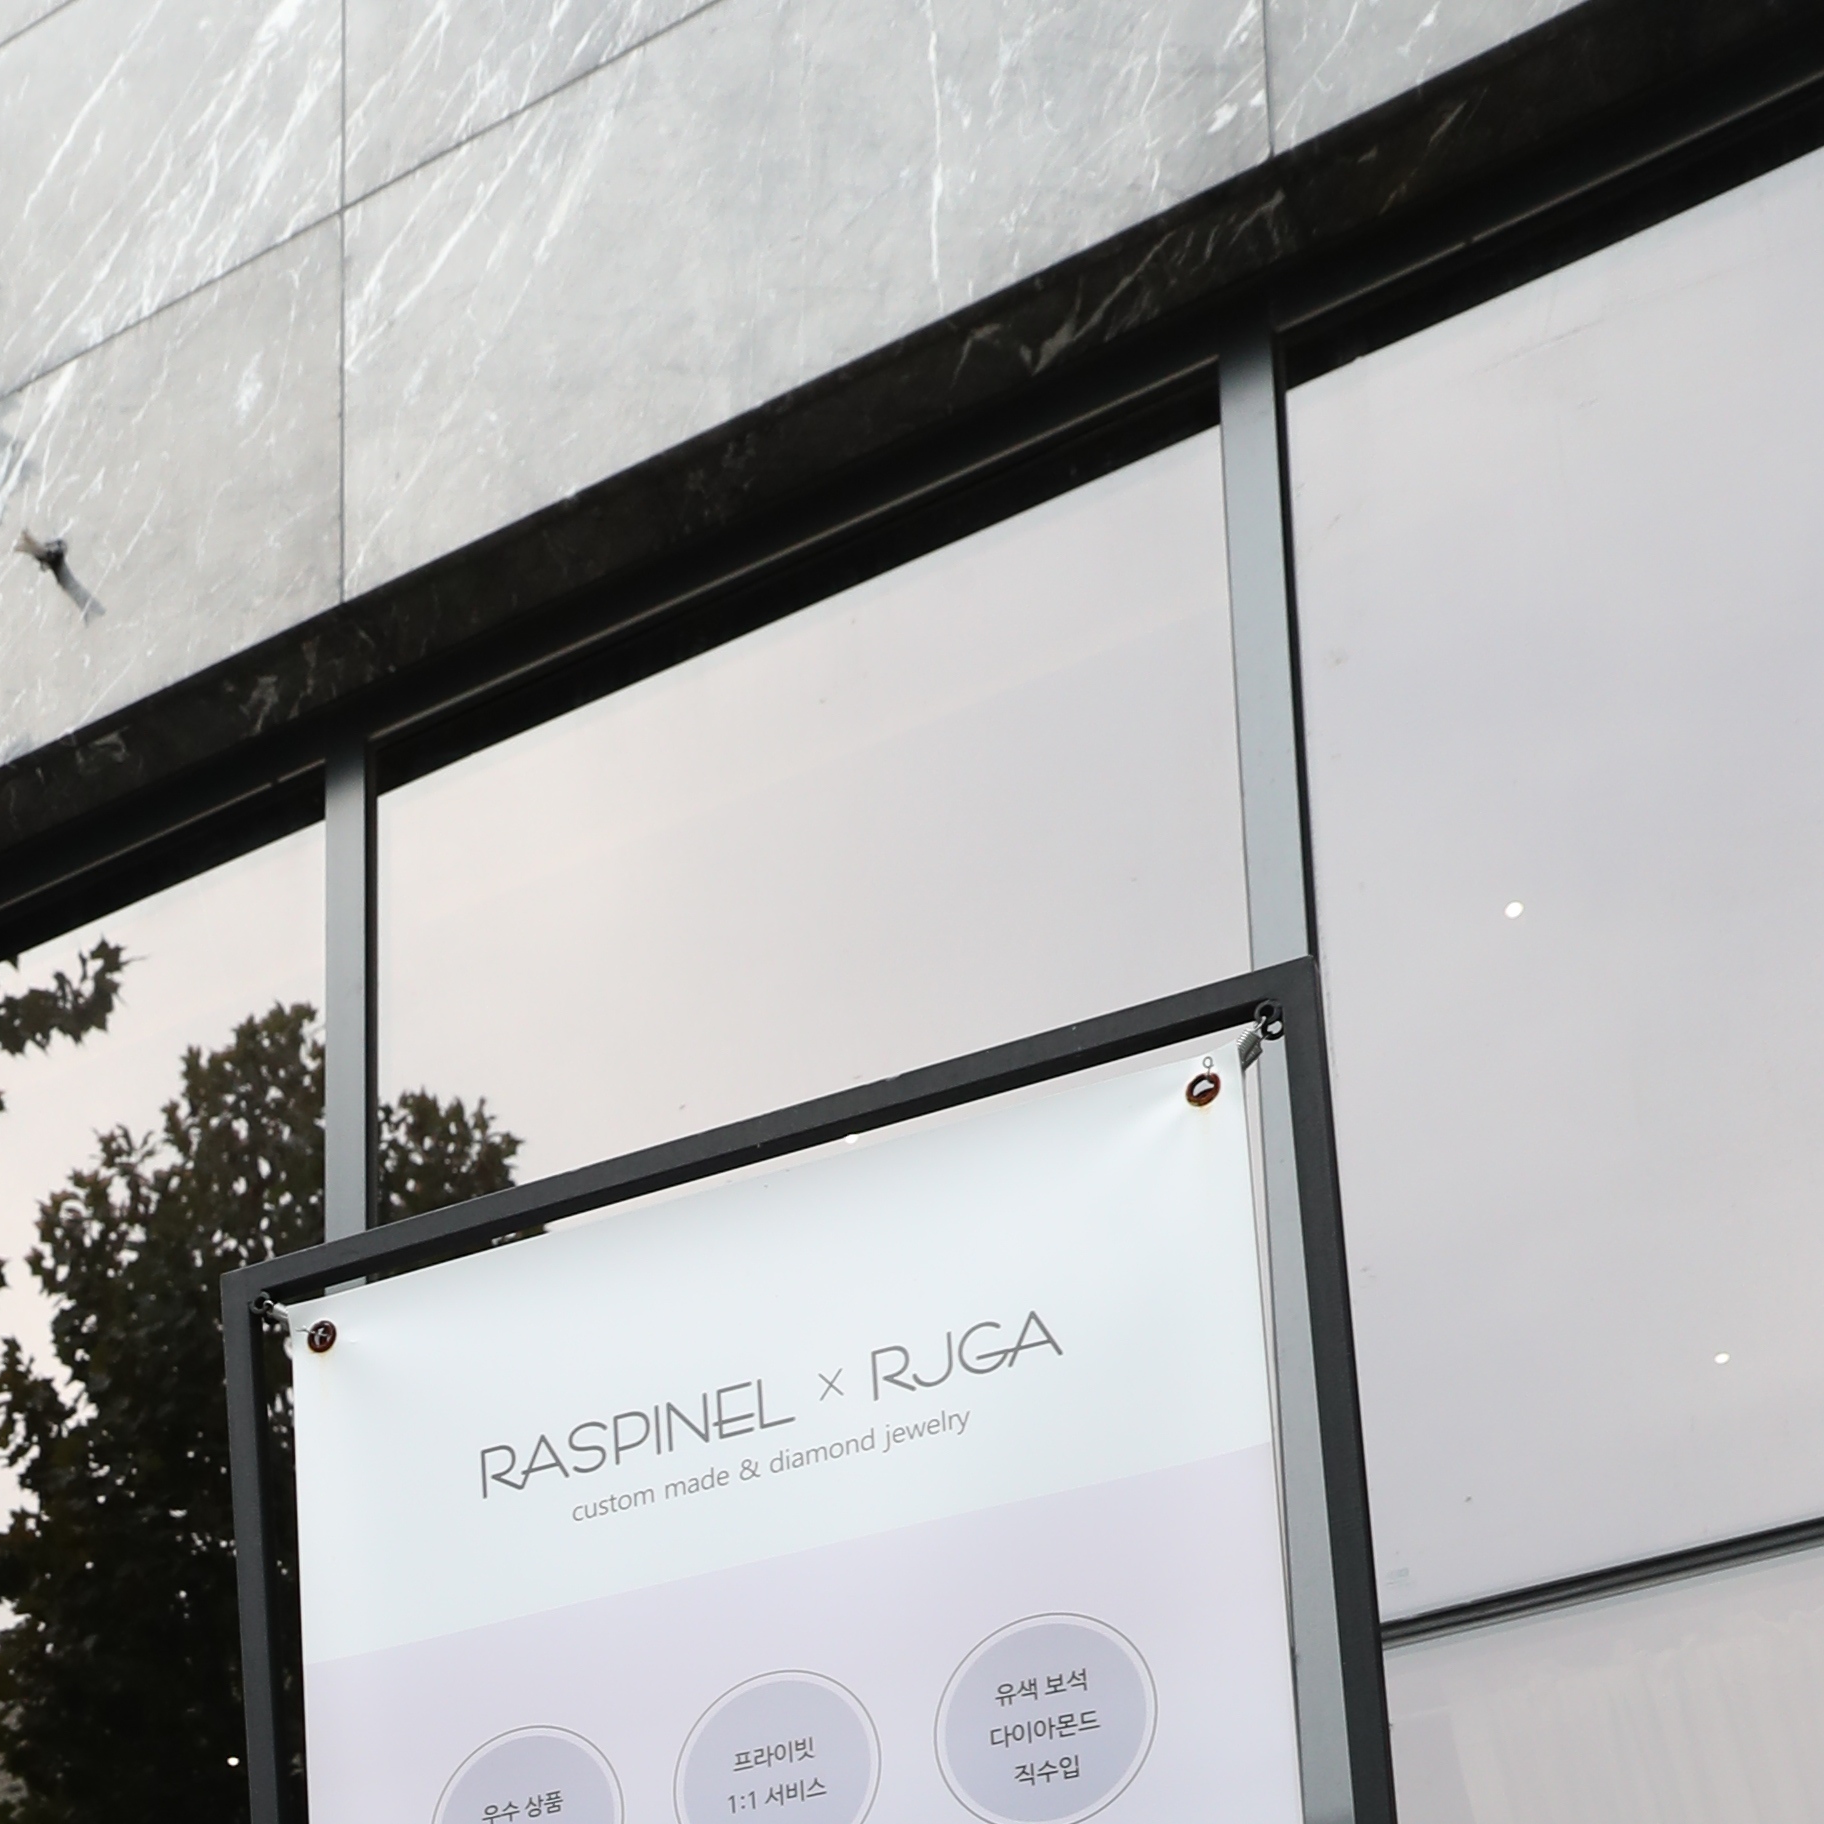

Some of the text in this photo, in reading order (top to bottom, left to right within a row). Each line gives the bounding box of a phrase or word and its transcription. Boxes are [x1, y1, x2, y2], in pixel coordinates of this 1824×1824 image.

[480, 1379, 796, 1499] RASPINEL
[573, 1411, 970, 1521] custom made & diamond jewelry
[995, 1668, 1087, 1706] 유색 보석
[990, 1711, 1100, 1748] 다이아몬드
[733, 1737, 815, 1771] 프라이빗
[1014, 1755, 1080, 1786] 직수입
[525, 1791, 563, 1817] 상품
[728, 1778, 827, 1813] 1:1 서비스
